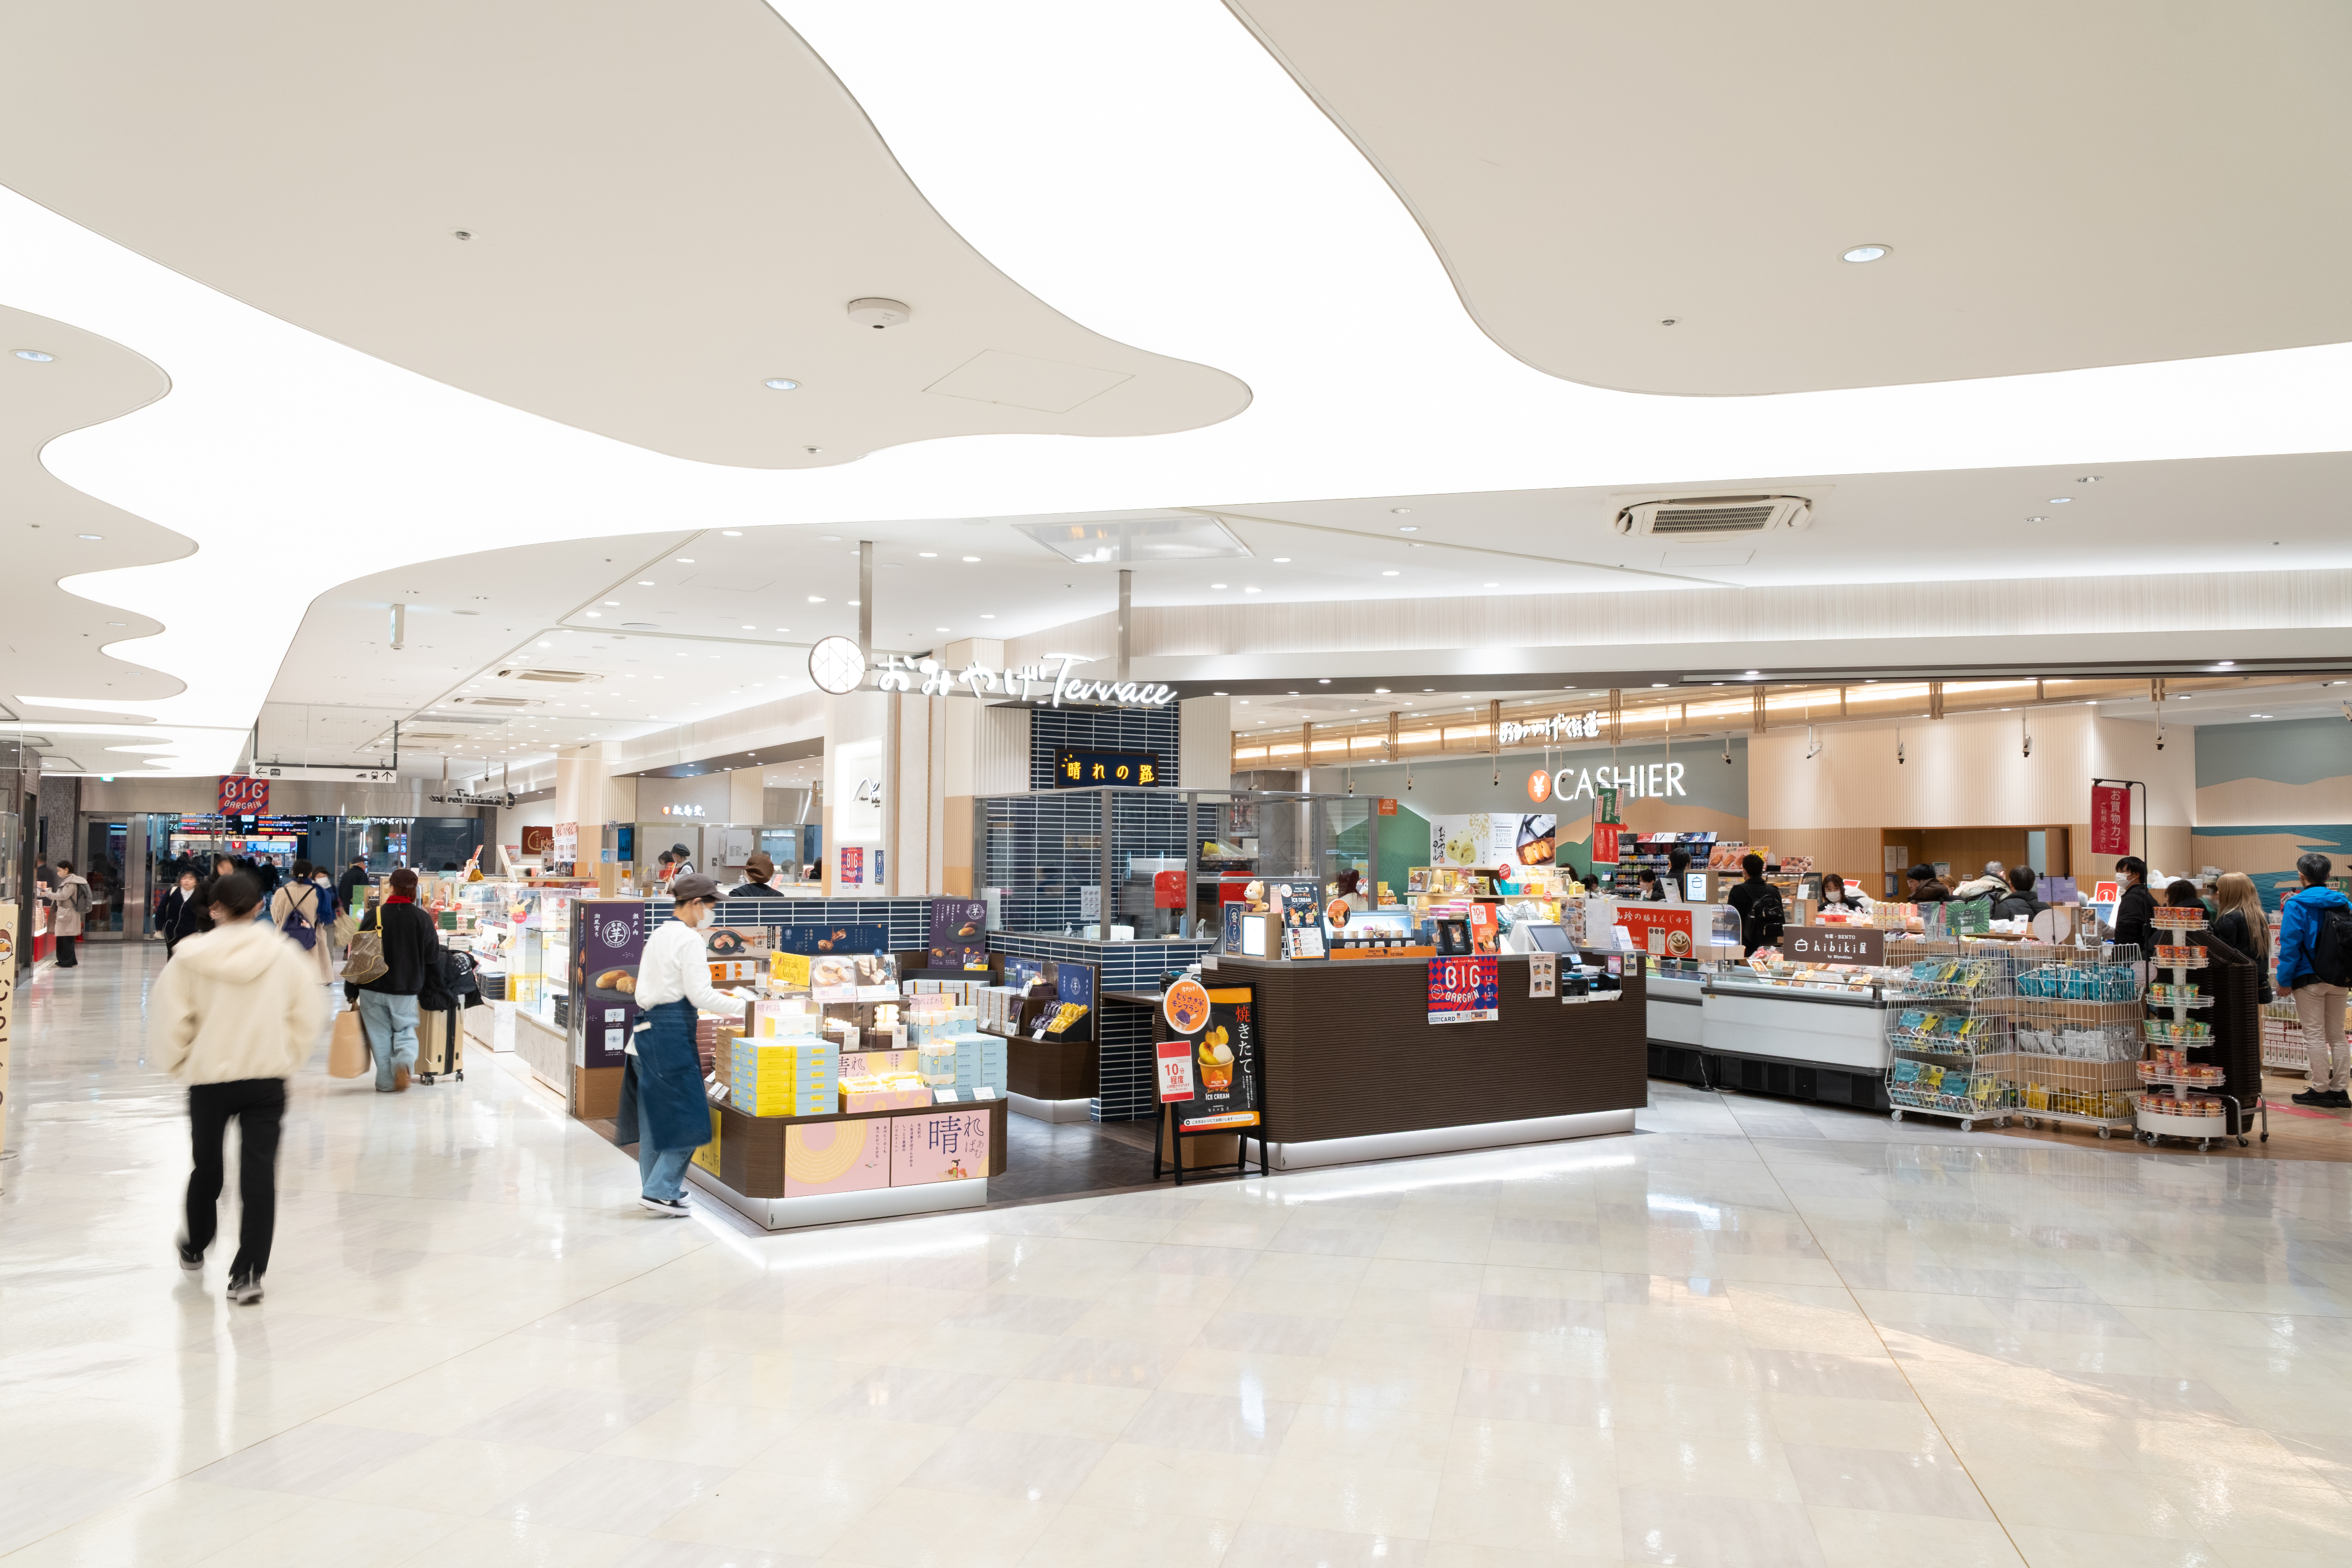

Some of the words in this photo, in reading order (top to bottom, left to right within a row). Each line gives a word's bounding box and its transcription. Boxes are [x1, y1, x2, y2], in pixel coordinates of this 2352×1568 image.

[1554, 763, 1686, 801] CASHIER
[225, 781, 264, 799] BIG
[224, 800, 262, 810] BARGAIN
[2110, 789, 2121, 848] お買物カゴ
[846, 853, 858, 868] BIG
[1617, 911, 1689, 925] 山珍の豚まんじゅう
[609, 927, 624, 942] 芋
[1814, 940, 1866, 954] hibiki屋
[1445, 965, 1480, 989] BIG
[1176, 992, 1205, 1006] むらさき芋
[1445, 989, 1480, 1003] BARGAIN
[1171, 1000, 1204, 1015] モンブラン！
[1236, 1005, 1252, 1073] 焼きたて
[1165, 1063, 1185, 1076] 10分
[1170, 1075, 1184, 1085] 程度
[929, 1116, 984, 1155] 晴れ
